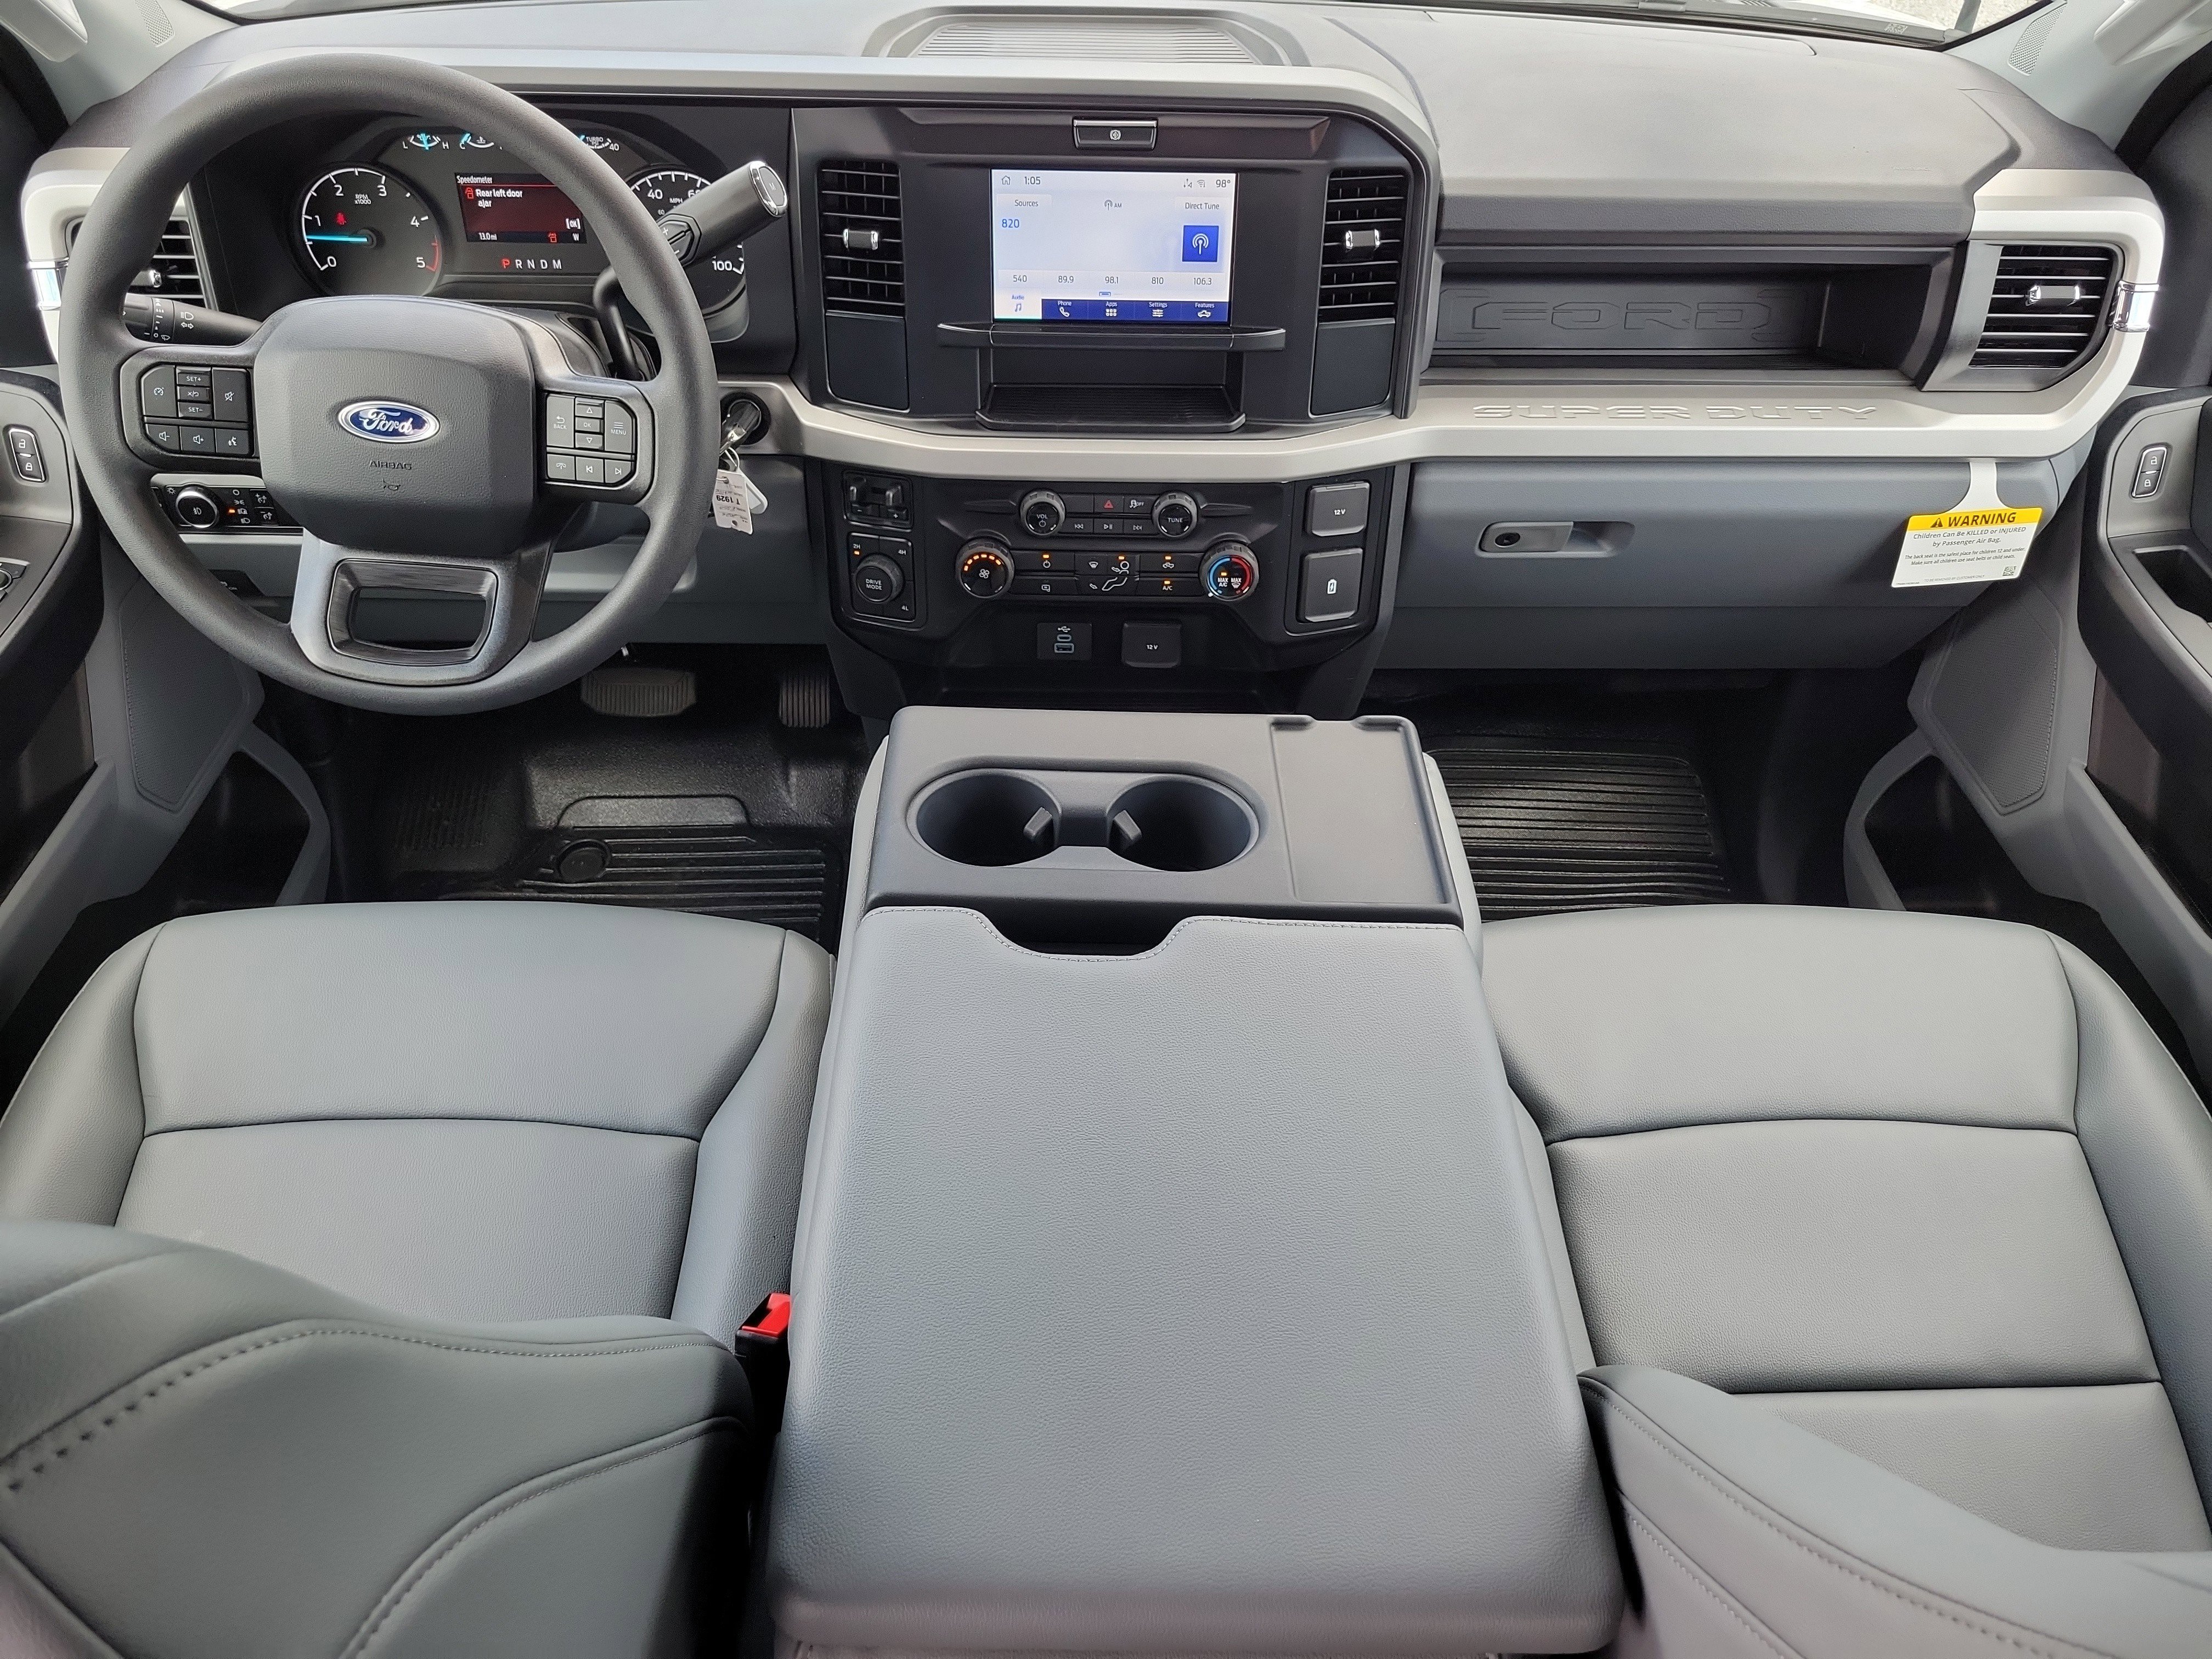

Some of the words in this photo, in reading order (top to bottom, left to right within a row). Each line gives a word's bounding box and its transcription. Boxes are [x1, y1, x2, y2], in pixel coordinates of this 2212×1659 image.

[403, 141, 408, 149] L
[443, 142, 449, 150] H
[610, 143, 619, 151] 40
[456, 176, 493, 184] Speedometer
[1024, 177, 1041, 185] 1:05
[1216, 179, 1231, 188] 98°
[334, 184, 344, 196] 2
[377, 185, 387, 196] 3
[475, 189, 492, 198] Rear
[493, 189, 506, 198] left
[506, 189, 523, 198] door
[647, 189, 663, 200] 40
[478, 199, 492, 208] ajar
[1014, 199, 1039, 207] Sources
[314, 216, 321, 226] 1
[410, 216, 420, 228] 4
[1002, 219, 1020, 228] 820
[572, 233, 579, 241] W
[328, 256, 337, 267] 0
[416, 257, 426, 268] 5
[501, 259, 510, 269] P
[516, 259, 523, 269] R
[527, 259, 535, 269] N
[540, 260, 548, 269] D
[553, 260, 562, 270] M
[713, 260, 733, 271] 100
[1472, 302, 1771, 329] FORD
[1472, 405, 1691, 420] SUPER
[1707, 406, 1876, 420] DUTY
[359, 408, 414, 434] Ford
[369, 460, 412, 470] AIRBAG
[716, 495, 733, 503] 1929
[1948, 512, 2016, 527] WARNING
